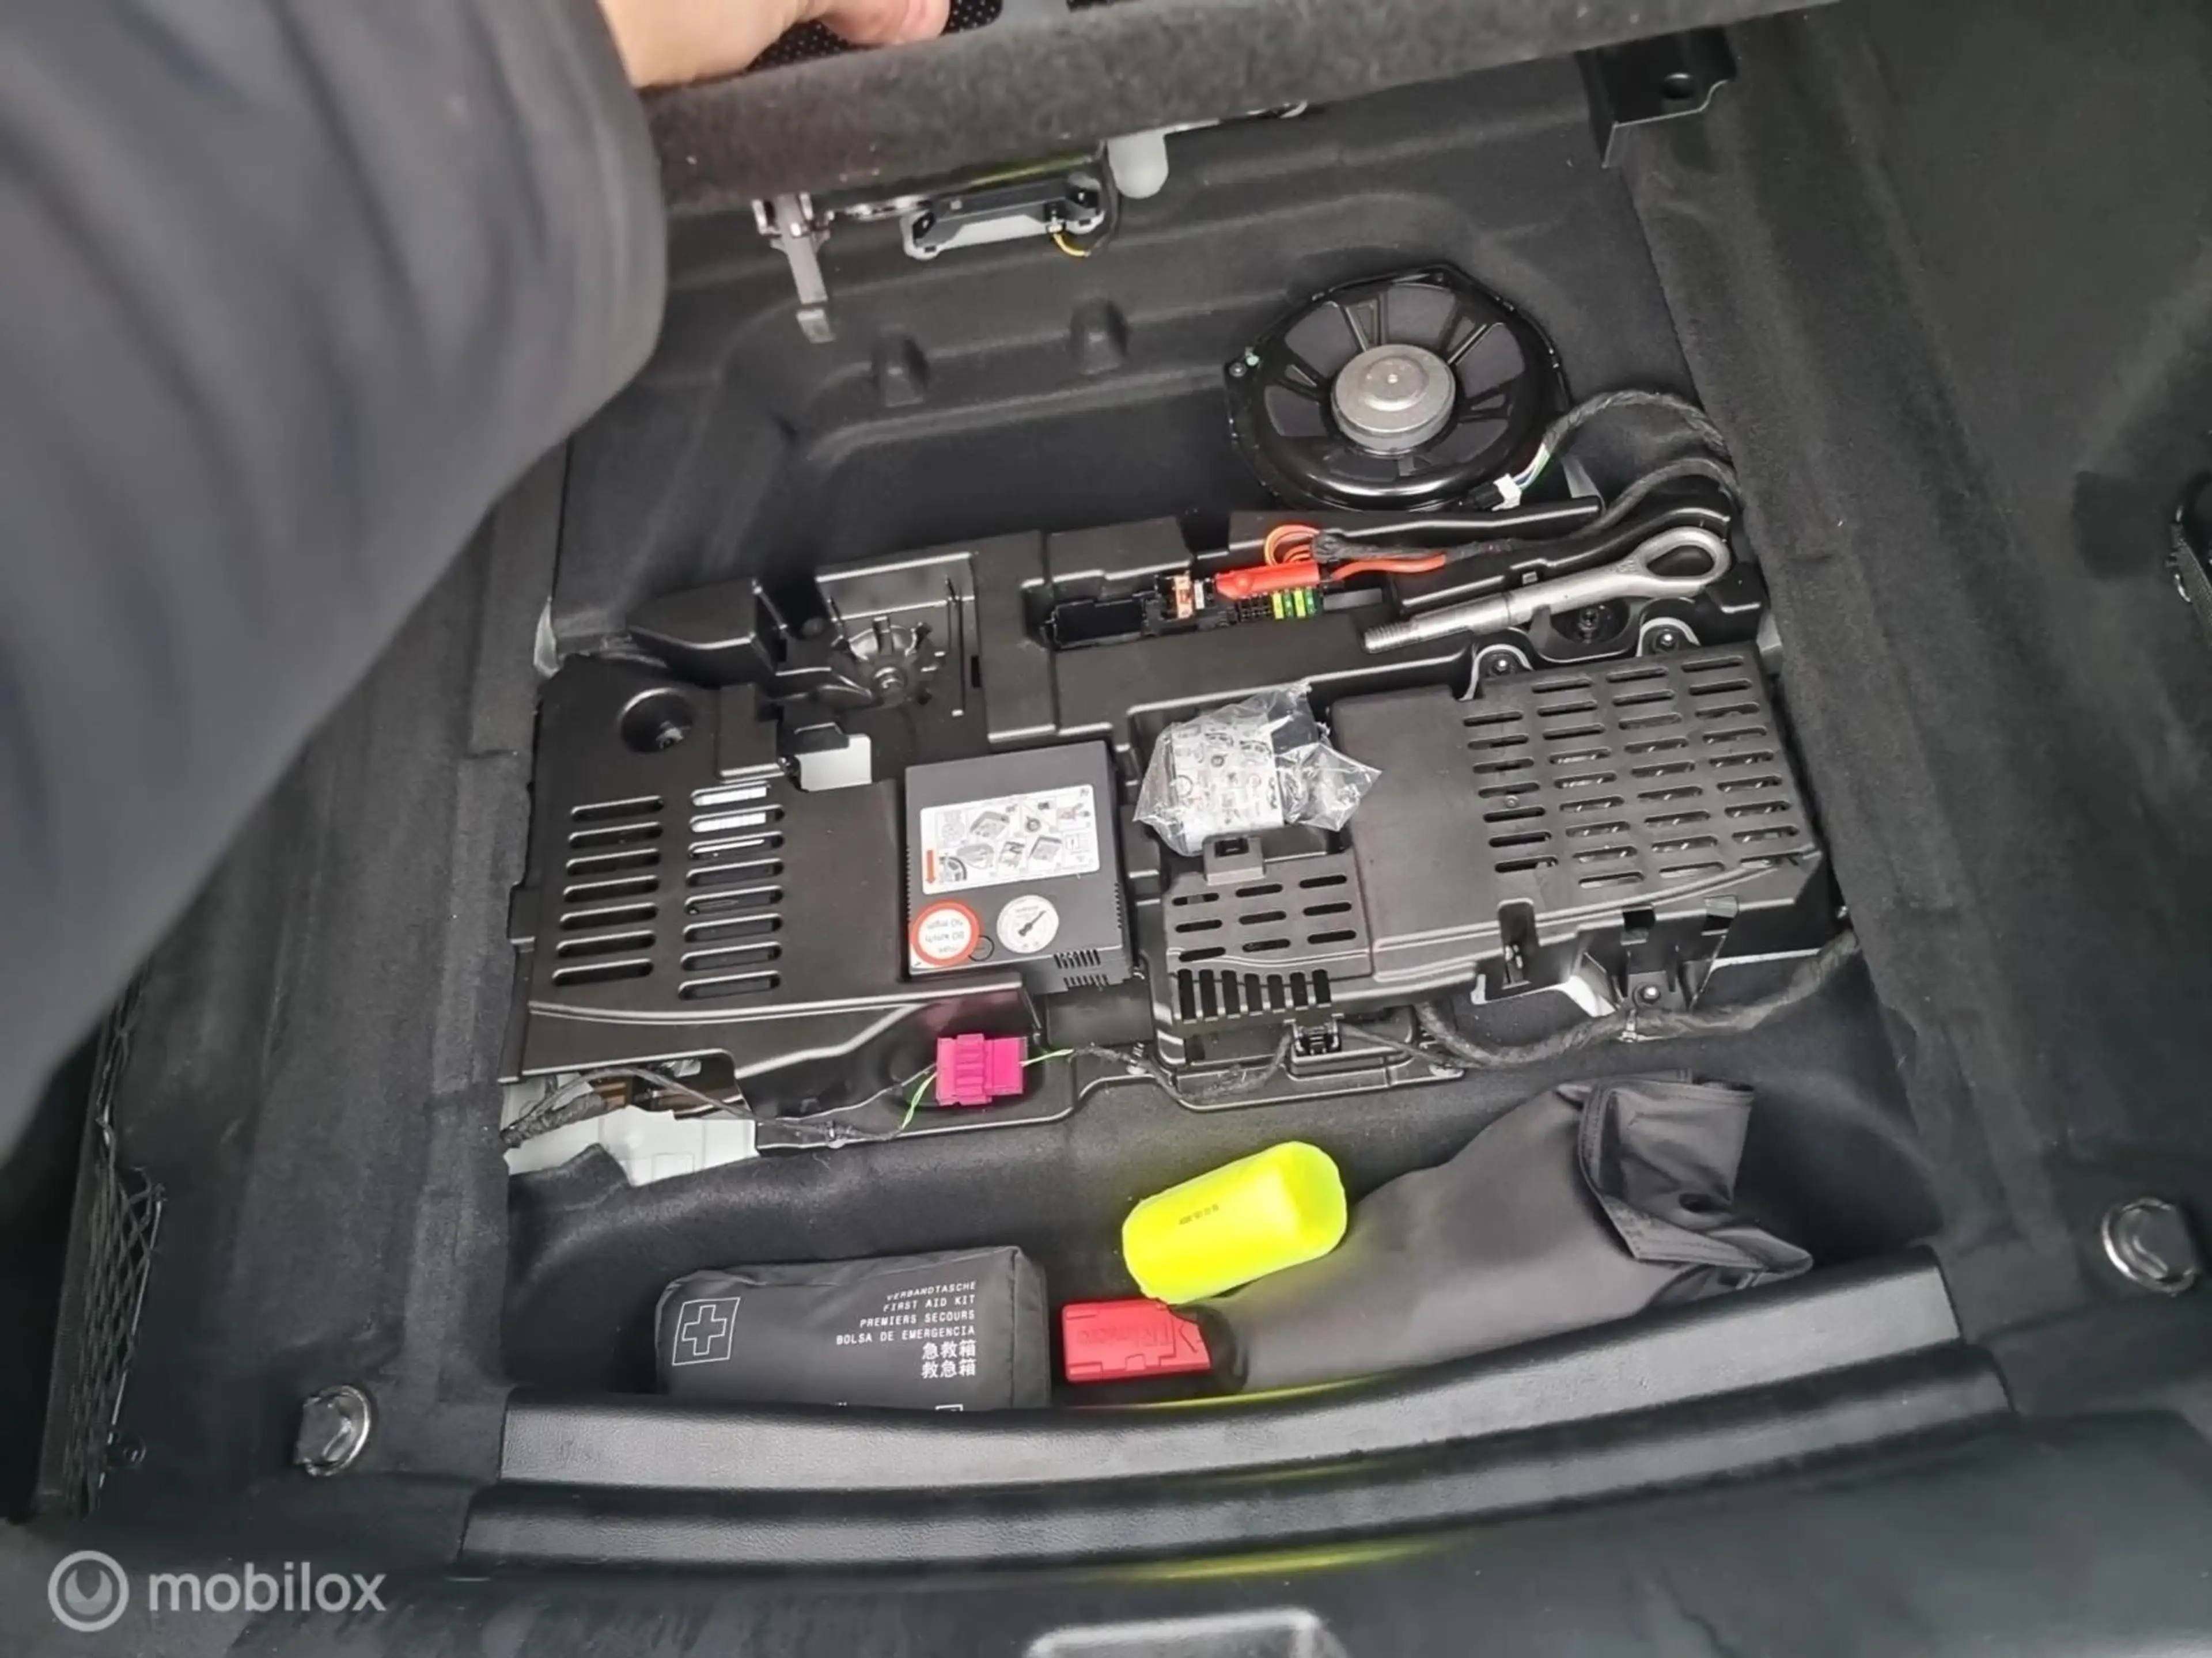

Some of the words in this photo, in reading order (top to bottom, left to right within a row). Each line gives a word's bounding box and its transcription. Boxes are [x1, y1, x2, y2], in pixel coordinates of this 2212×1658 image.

[887, 1281, 976, 1300] VERBANDTASCHE
[882, 1300, 918, 1312] FIRST
[925, 1297, 948, 1308] AID
[955, 1294, 975, 1305] KIT
[859, 1314, 917, 1328] PREMIERS
[924, 1310, 975, 1323] SECOURS
[836, 1333, 873, 1345] BOLSA
[880, 1331, 895, 1342] DE
[902, 1325, 976, 1340] EMERGENCIA
[922, 1339, 977, 1360] 急救箱
[921, 1357, 977, 1379] 救急箱
